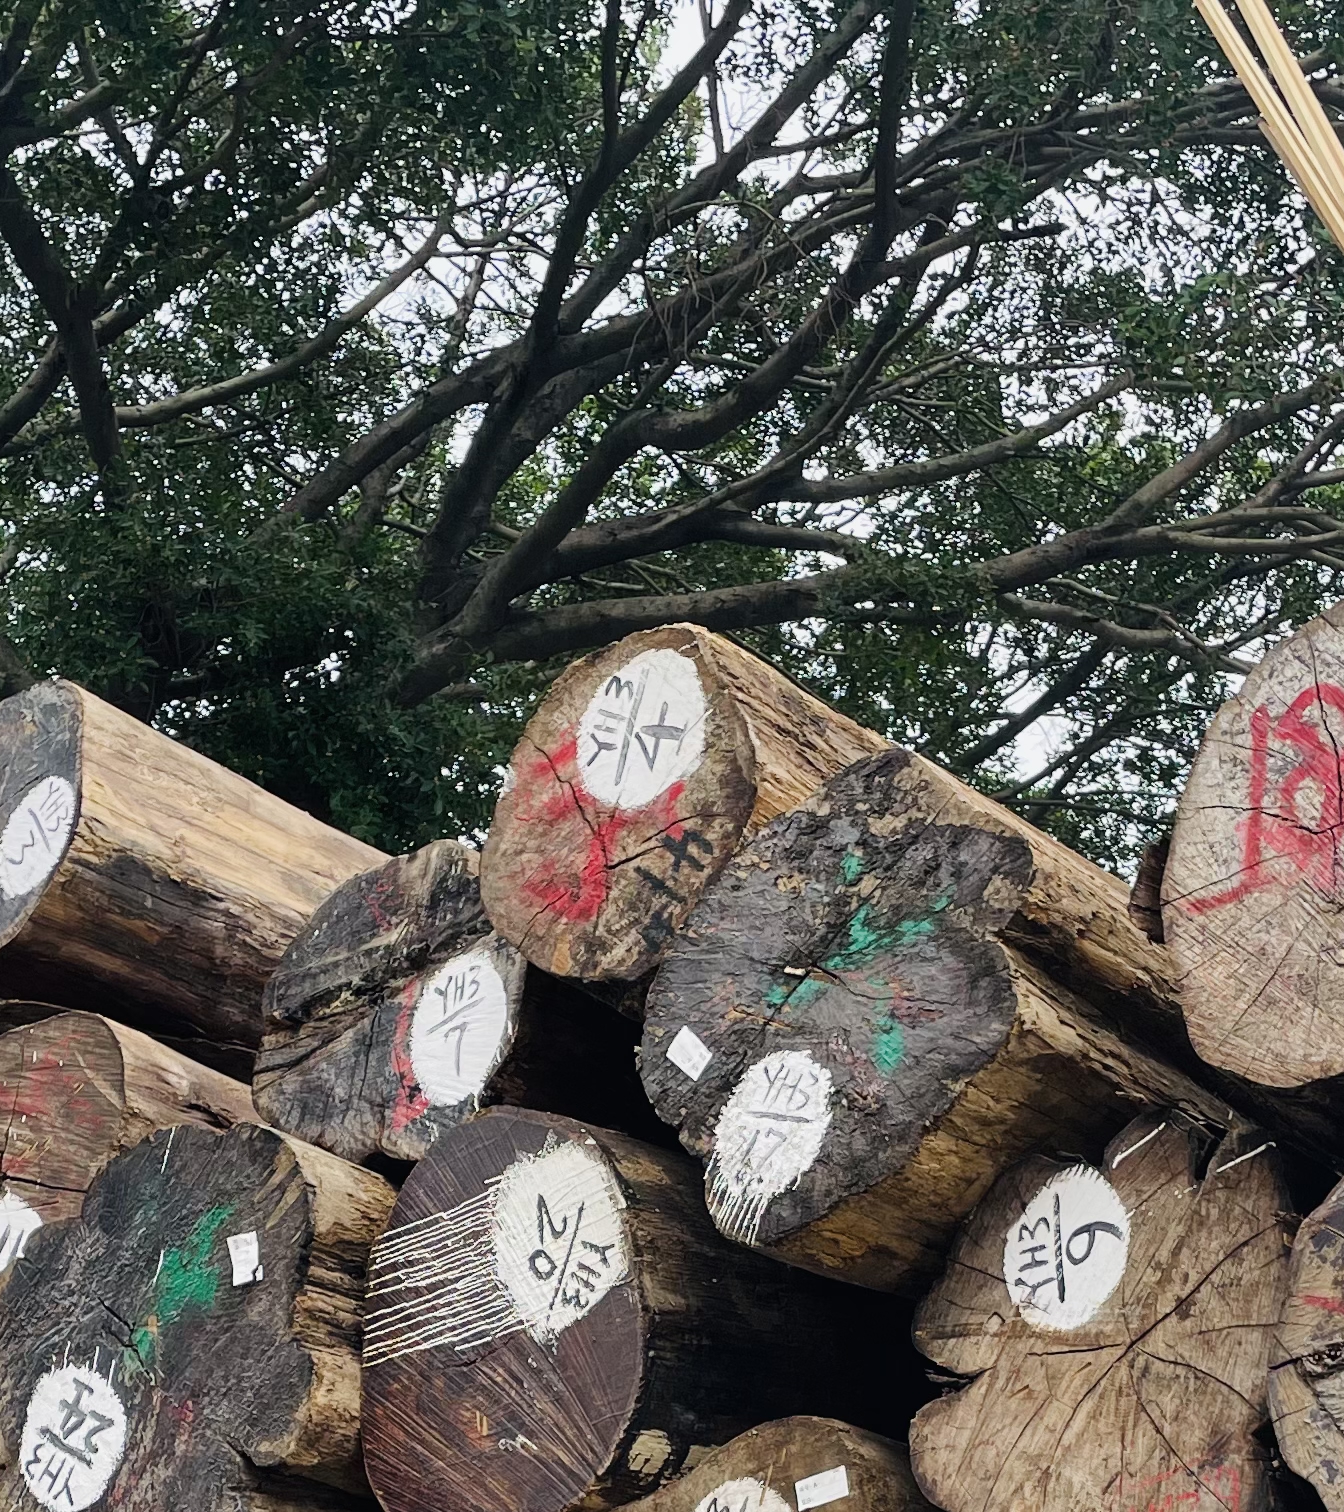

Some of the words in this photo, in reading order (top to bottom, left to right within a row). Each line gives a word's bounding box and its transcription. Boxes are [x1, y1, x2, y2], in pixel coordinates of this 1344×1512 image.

[586, 675, 635, 767] YH3
[635, 701, 690, 772] 4
[434, 965, 482, 1016] YH3
[444, 1021, 470, 1077] 7
[762, 1062, 820, 1110] YH3
[563, 1239, 616, 1311] YH3
[1013, 1216, 1057, 1314] YH3
[58, 1376, 116, 1455] 24
[24, 1442, 76, 1507] YH3
